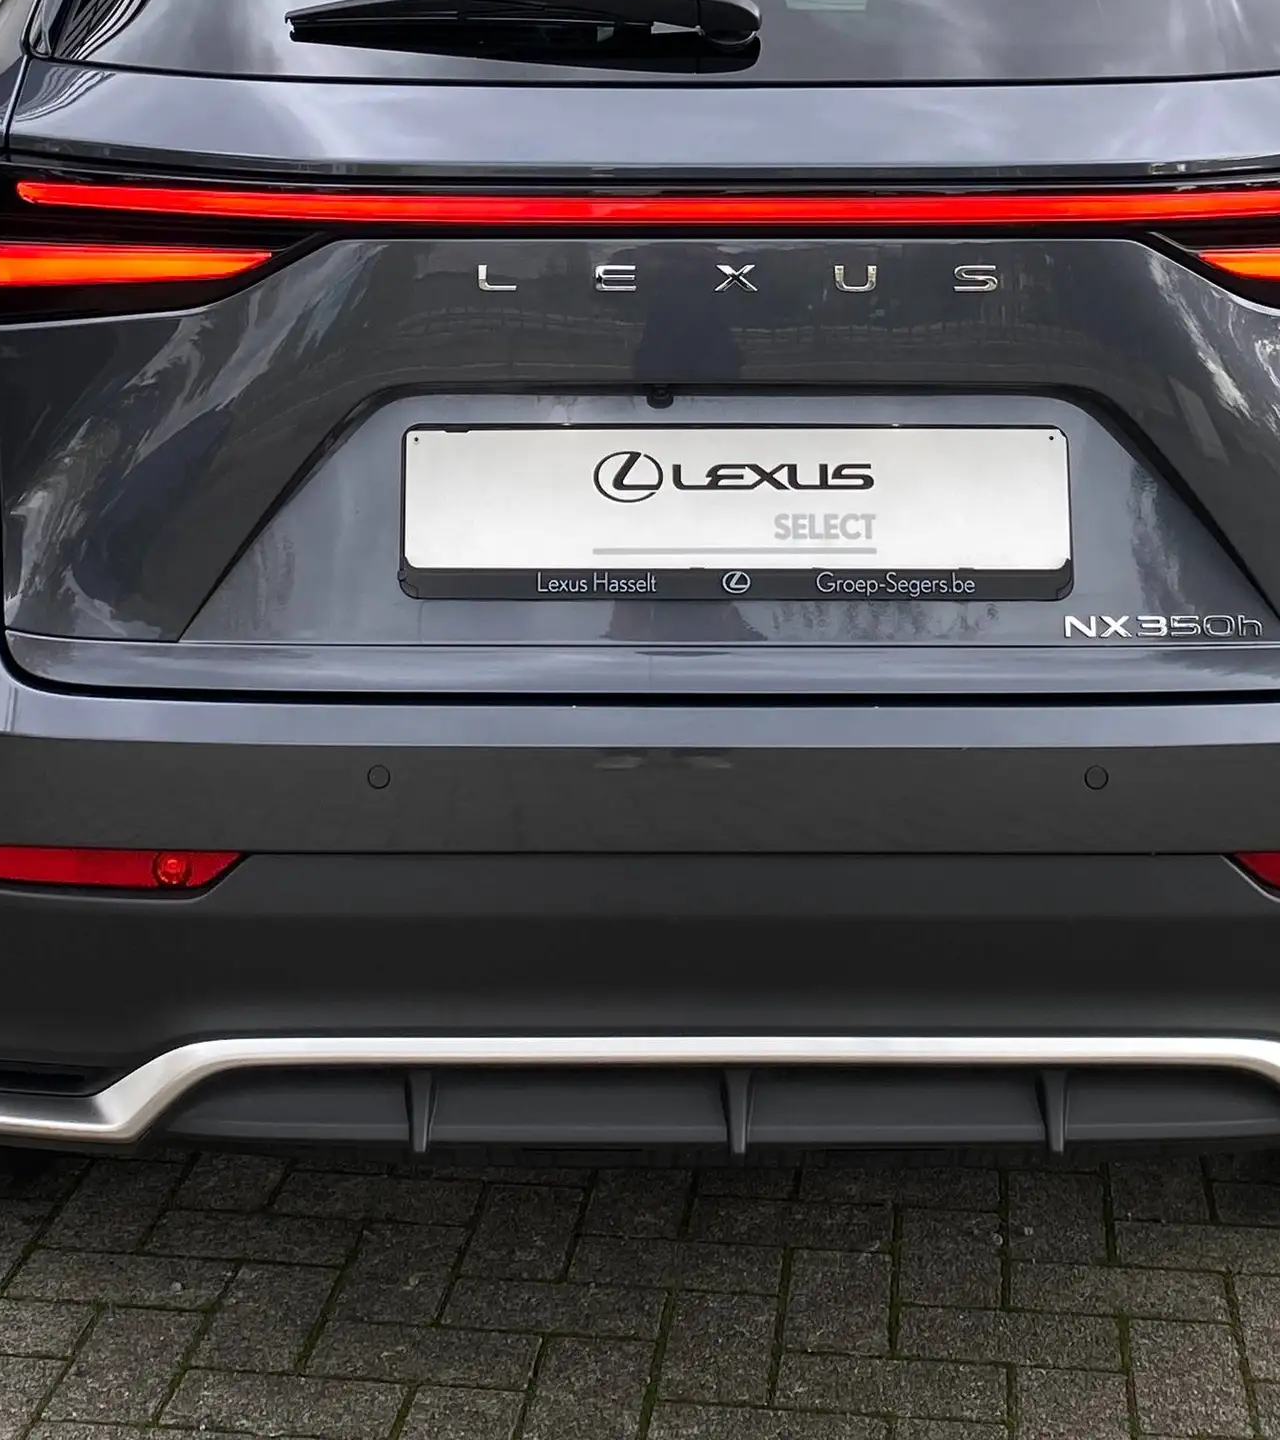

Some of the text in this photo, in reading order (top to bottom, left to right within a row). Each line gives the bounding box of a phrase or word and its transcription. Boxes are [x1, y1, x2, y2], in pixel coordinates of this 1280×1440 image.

[478, 263, 1000, 293] LEXUS
[672, 463, 875, 490] LEXUS
[773, 513, 876, 540] SELECT
[536, 572, 658, 593] Lexus Hasselt
[816, 571, 976, 597] Groep-Segers.be
